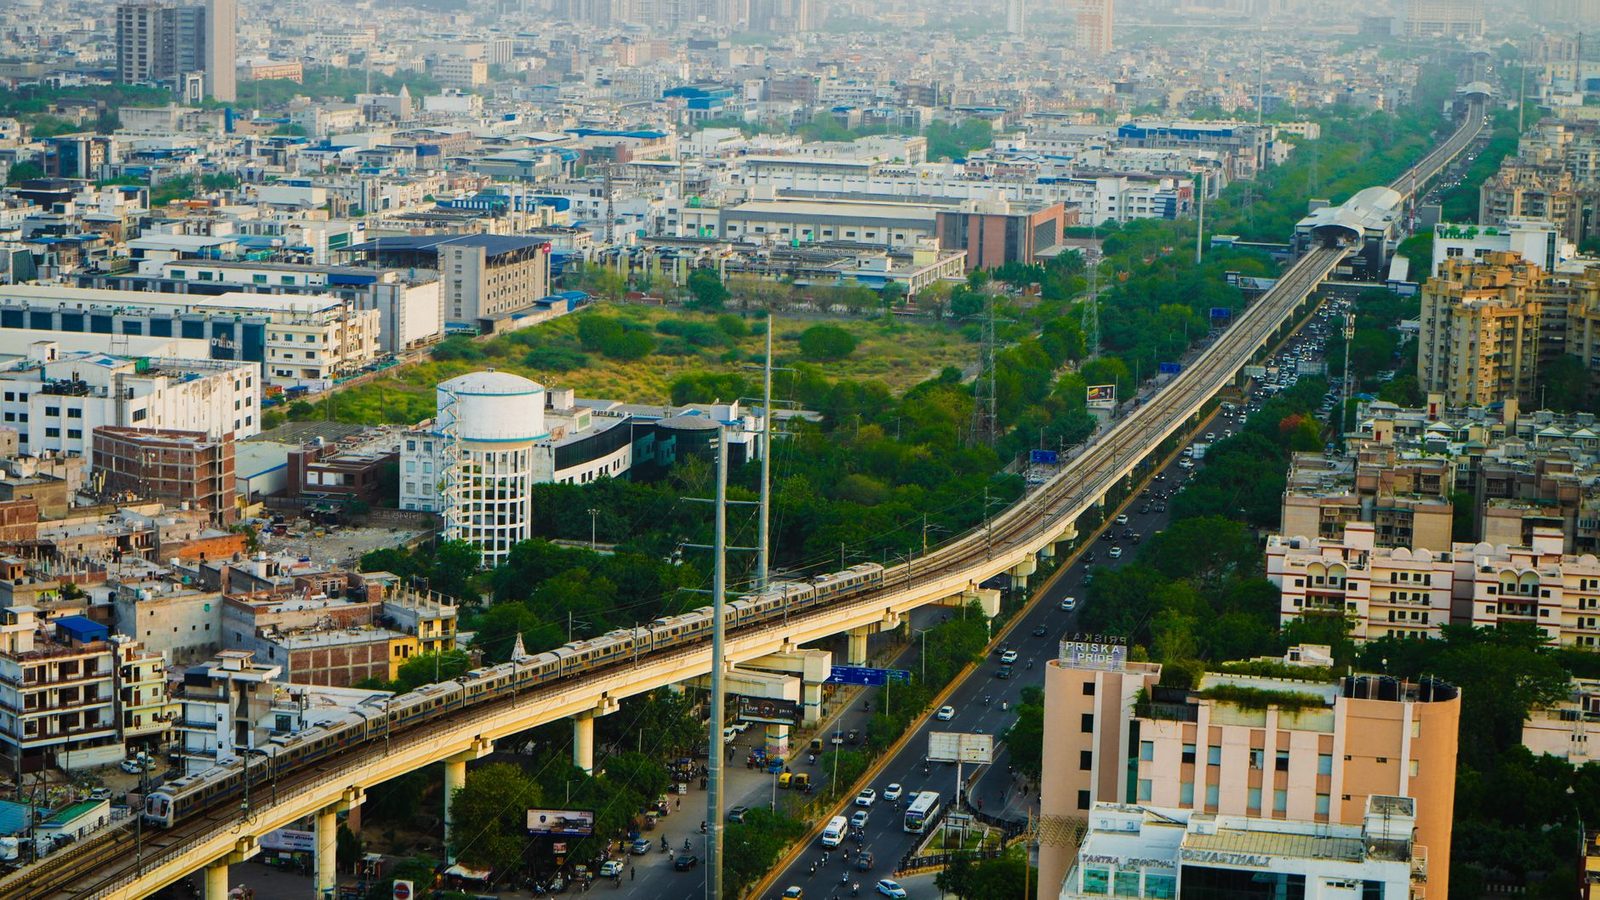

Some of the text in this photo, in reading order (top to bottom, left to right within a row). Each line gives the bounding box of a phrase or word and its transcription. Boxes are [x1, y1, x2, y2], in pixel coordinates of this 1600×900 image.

[1065, 641, 1121, 654] PRISKA
[1077, 652, 1113, 663] PRIDE
[1082, 854, 1119, 864] TANTRA
